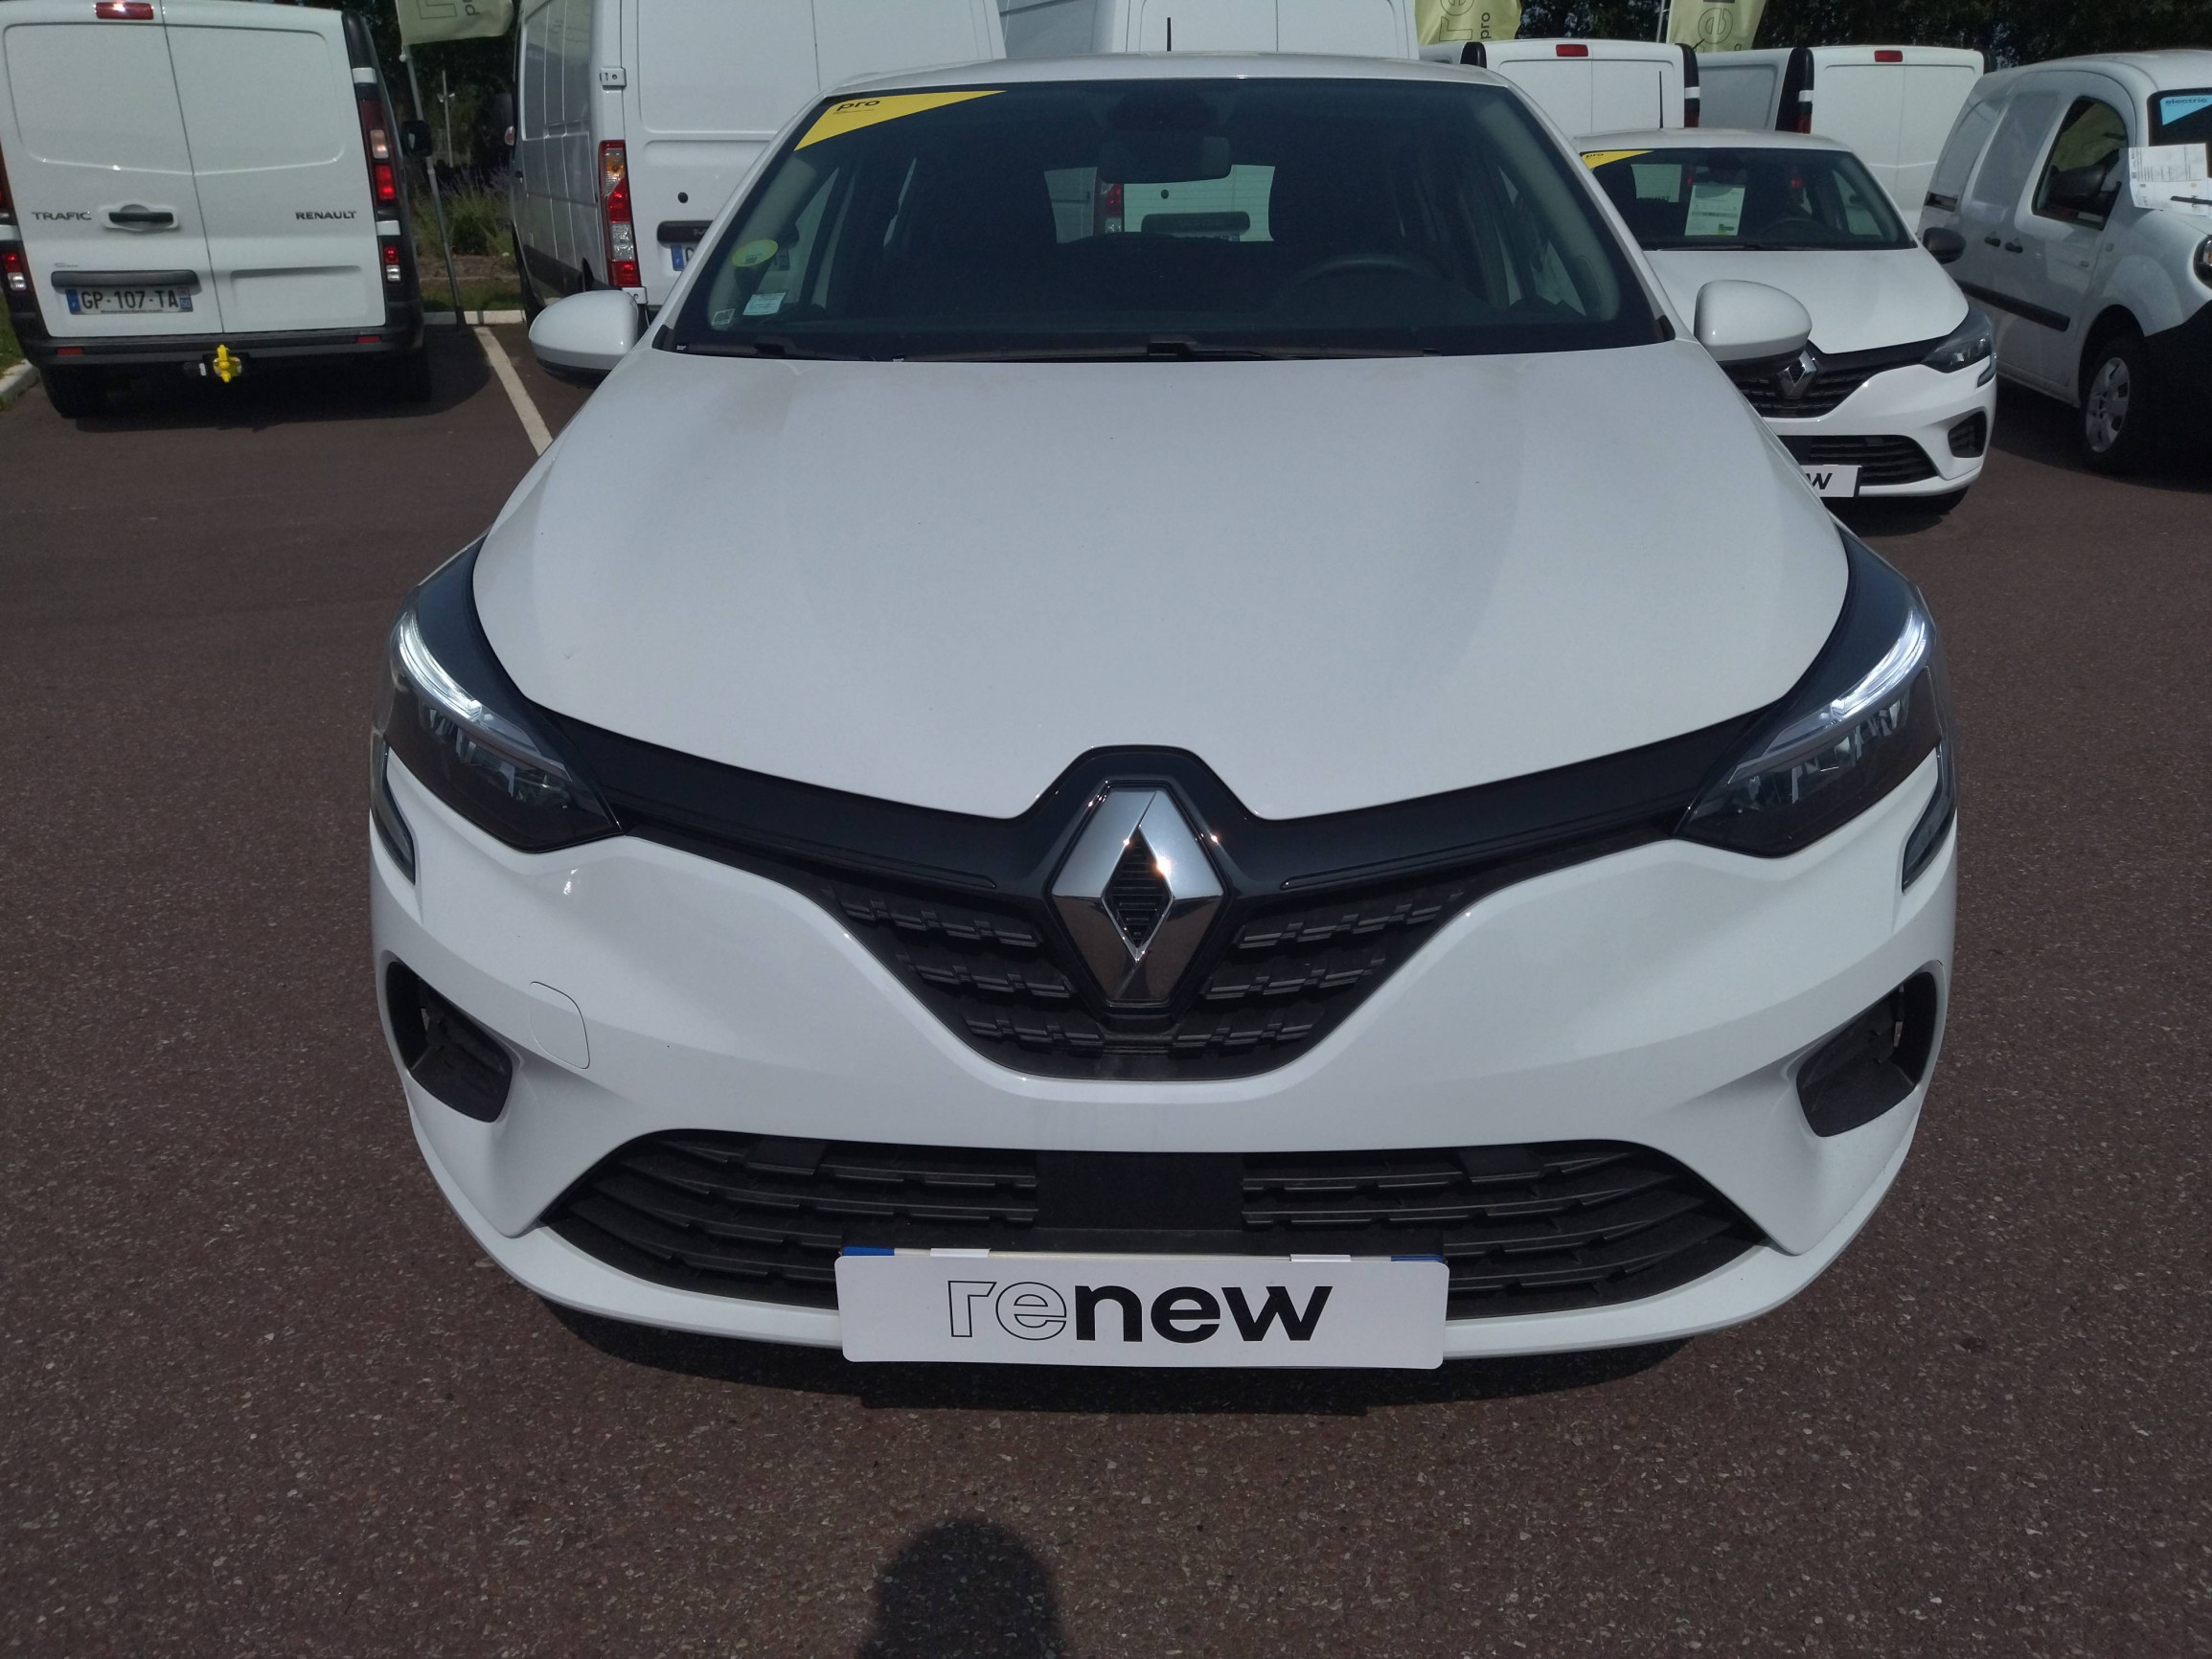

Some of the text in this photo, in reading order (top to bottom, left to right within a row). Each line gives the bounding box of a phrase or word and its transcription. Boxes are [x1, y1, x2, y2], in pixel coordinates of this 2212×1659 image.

[1480, 11, 1492, 39] pro
[835, 100, 880, 111] pro
[32, 212, 92, 220] TRAFIC
[295, 211, 356, 219] RENAULT
[80, 289, 179, 310] GP-107-TA
[946, 1279, 1334, 1344] renew
